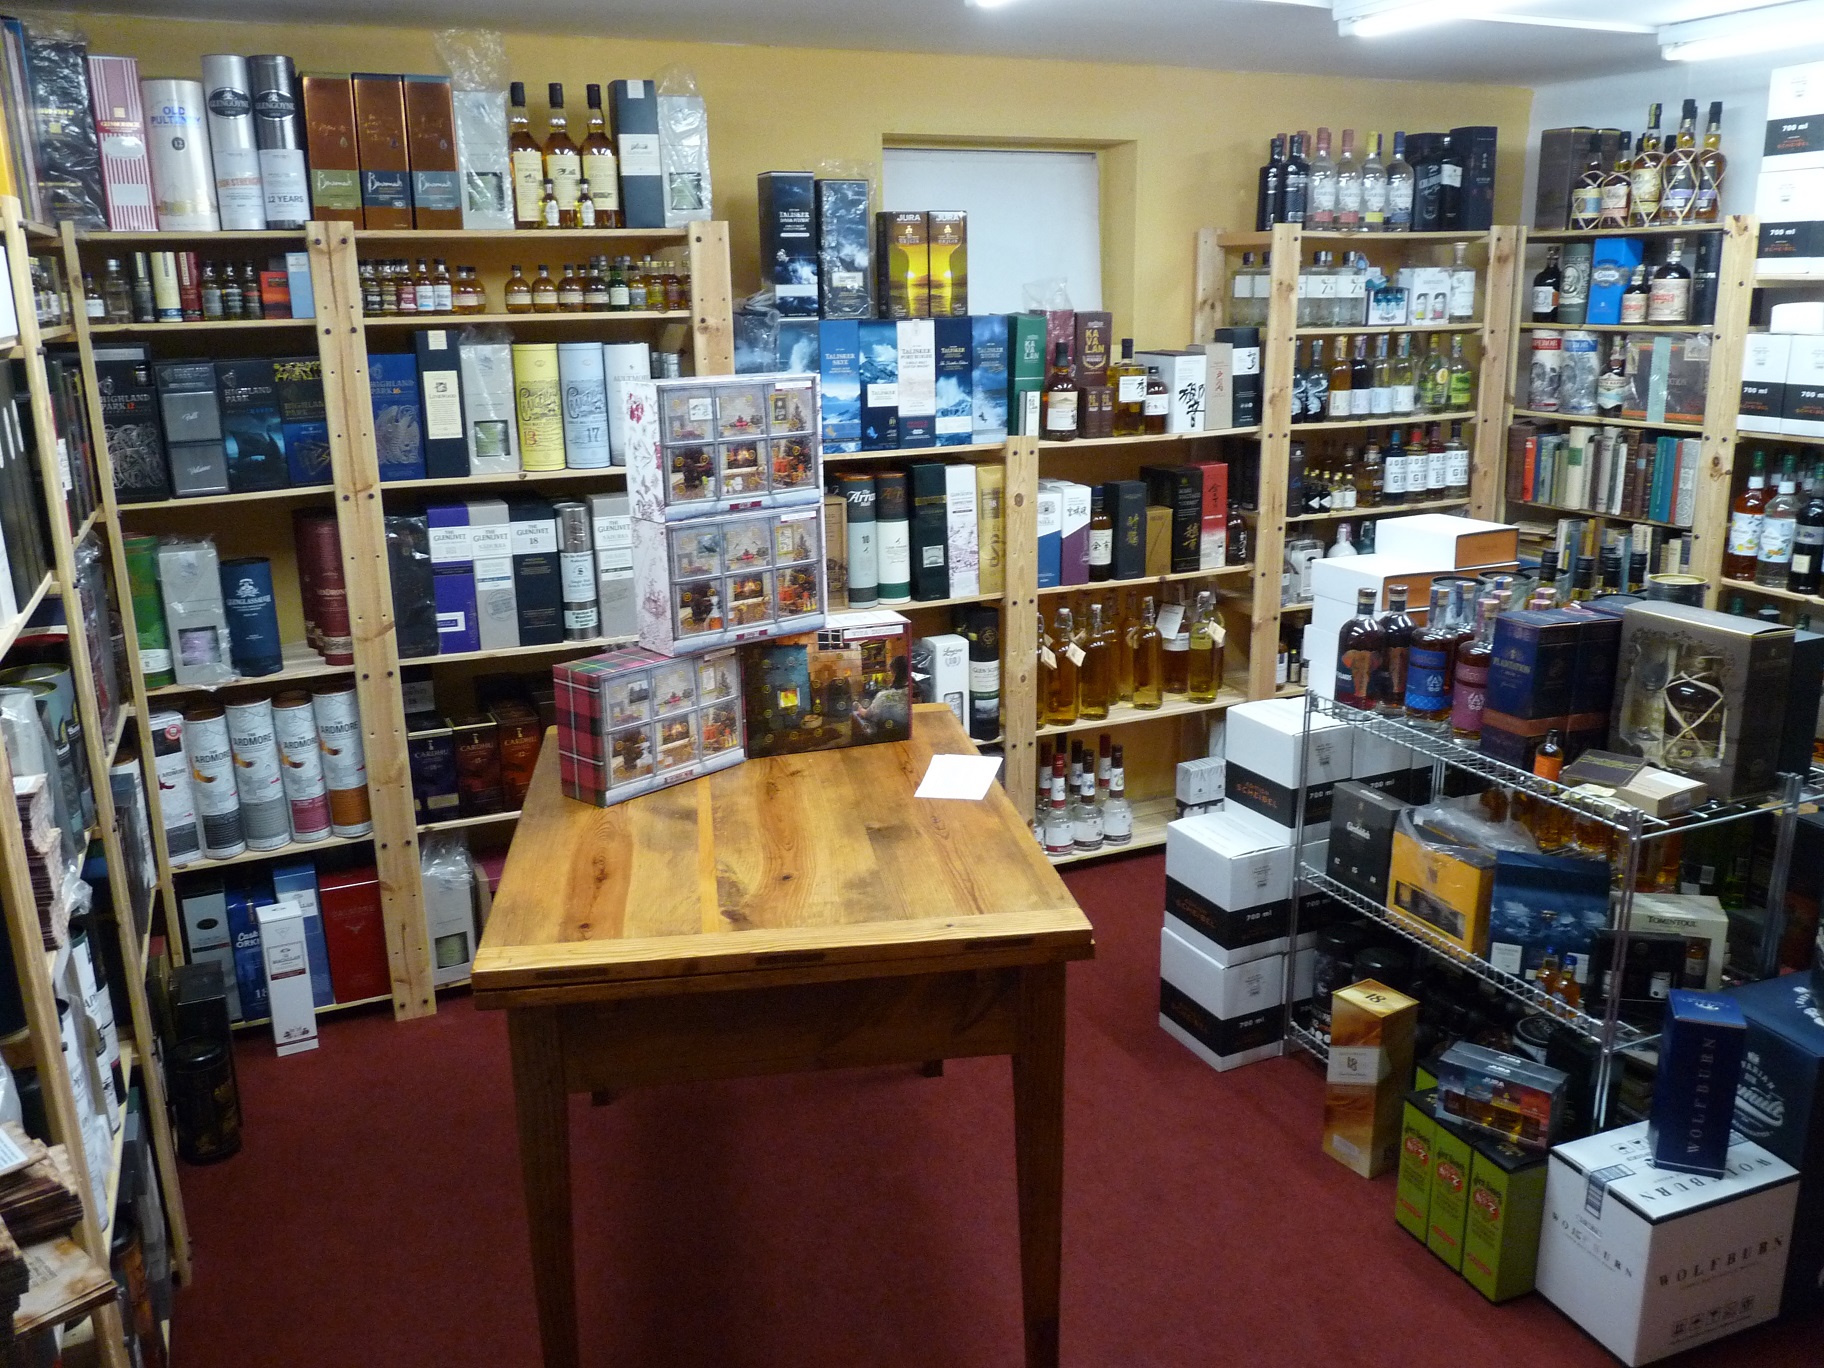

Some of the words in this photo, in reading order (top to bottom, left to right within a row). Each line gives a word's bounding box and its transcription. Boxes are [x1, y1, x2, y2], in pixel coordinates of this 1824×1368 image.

[209, 100, 249, 108] GLENGOYNE
[255, 102, 295, 110] GLENGOYNE
[162, 106, 185, 115] OLD
[1782, 124, 1797, 132] 700
[1797, 122, 1809, 130] ml
[267, 195, 277, 203] 12
[278, 195, 304, 203] YEARS
[896, 213, 921, 222] JURA
[935, 213, 960, 222] JURA
[1086, 329, 1099, 338] KA
[1085, 345, 1105, 353] LAN
[1024, 352, 1039, 360] LAN
[224, 386, 272, 396] HIGHLAND
[100, 393, 151, 403] HIGHLAND
[225, 395, 250, 403] PARK
[102, 402, 126, 410] PARK
[523, 431, 538, 446] 13
[586, 427, 600, 442] 17
[516, 528, 549, 536] GLENLIVET
[597, 524, 630, 533] GLENLIVET
[433, 533, 467, 541] GLENLIVET
[473, 533, 508, 542] GLENLIVET
[529, 537, 539, 545] 18
[320, 721, 359, 734] ARDMORE
[233, 733, 272, 746] ARDMORE
[284, 736, 317, 749] ARDMORE
[505, 736, 537, 746] CARDHU
[460, 743, 494, 751] CARDHU
[195, 752, 231, 764] ARDMORE
[415, 749, 449, 758] CARDHU
[162, 767, 186, 777] ARDMORE
[1370, 781, 1384, 789] 700
[1309, 791, 1326, 799] 700
[1246, 912, 1262, 922] 700
[1262, 910, 1273, 918] ml
[238, 930, 259, 942] Cask
[255, 988, 268, 998] 18
[1366, 993, 1387, 1003] 18
[1239, 1019, 1255, 1029] 700
[1255, 1016, 1265, 1025] ml
[1482, 1077, 1505, 1088] JURA
[1687, 1037, 1716, 1153] WOLFBURN
[1640, 1157, 1772, 1202] WOLBURN
[1658, 1236, 1784, 1287] WOLFBURN
